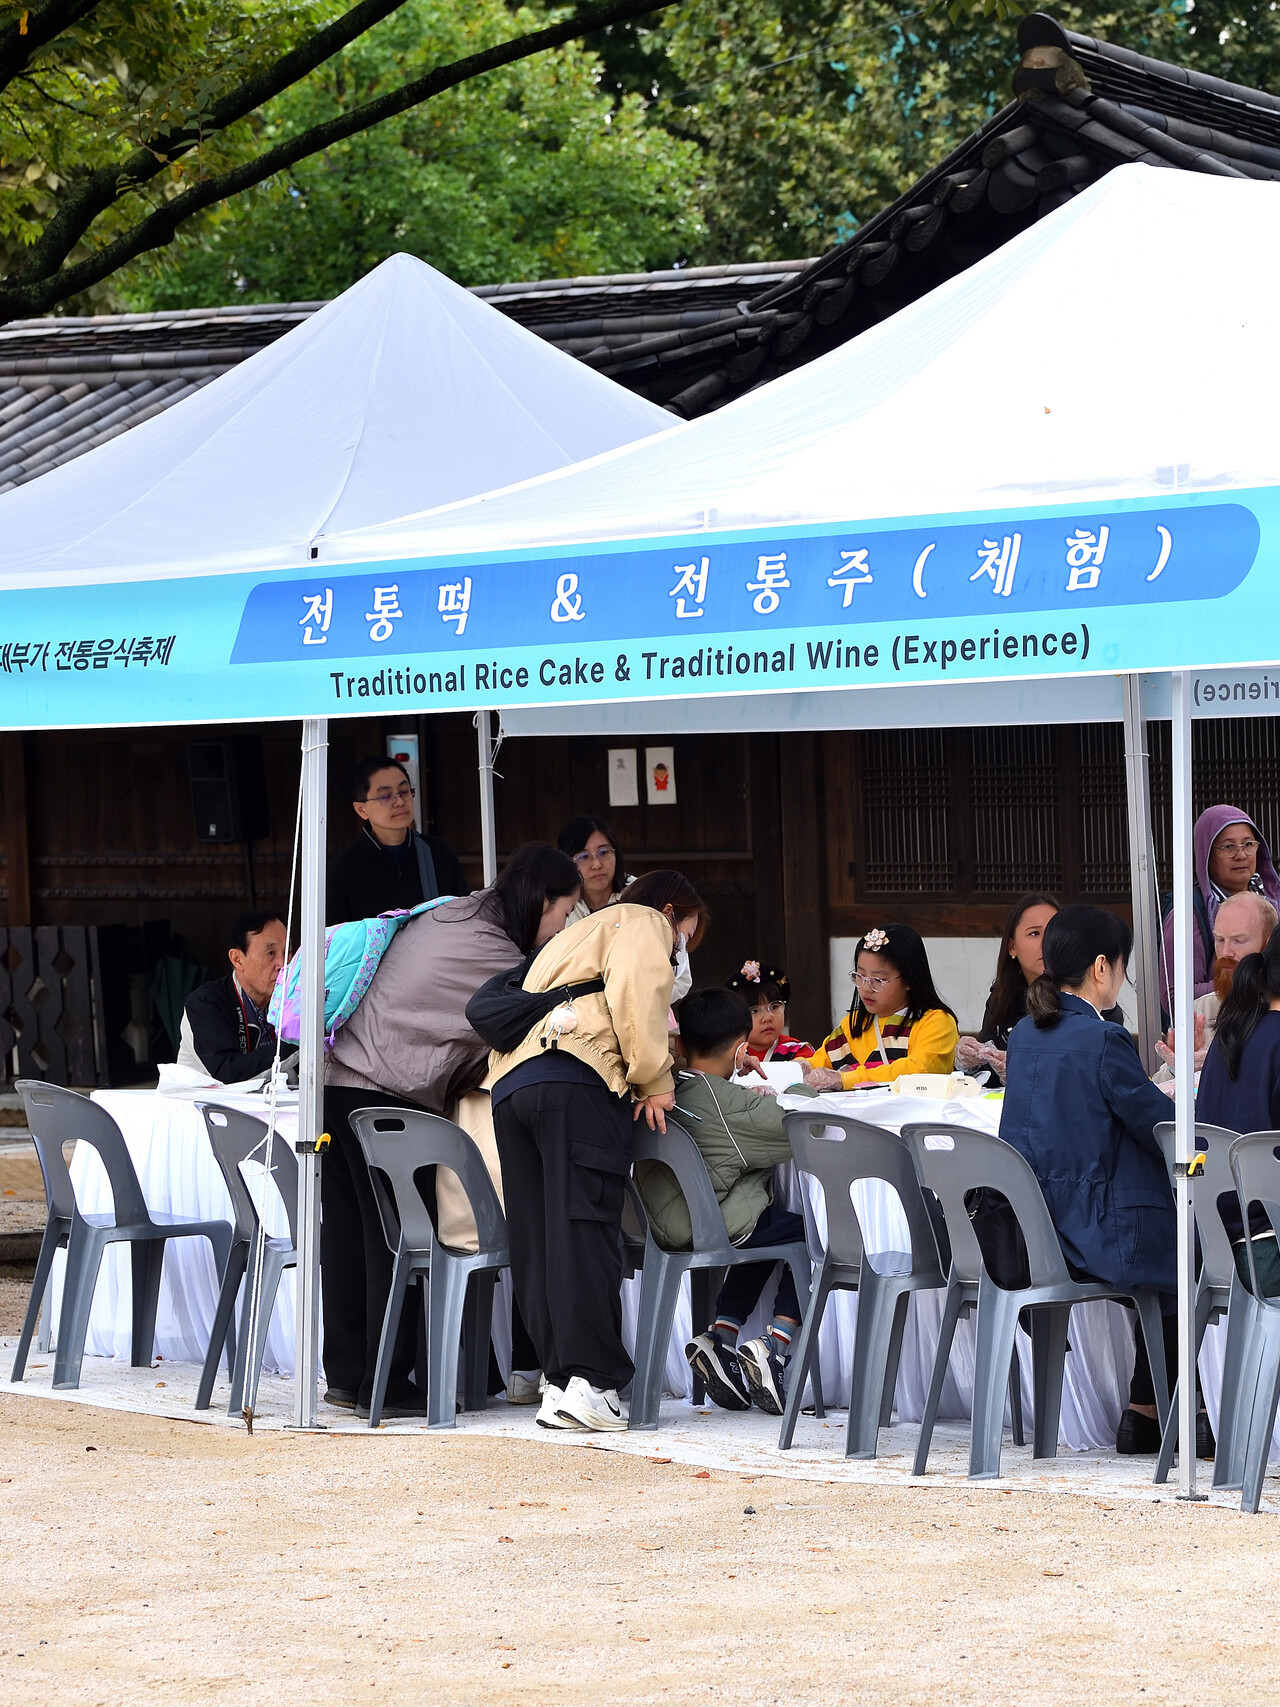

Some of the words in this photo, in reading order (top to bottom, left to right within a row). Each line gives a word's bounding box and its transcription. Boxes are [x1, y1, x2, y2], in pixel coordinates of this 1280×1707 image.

[548, 573, 586, 623] &
[54, 635, 177, 670] 전통음식축제
[330, 665, 466, 699] Traditional
[474, 658, 529, 691] Rice
[538, 655, 604, 688] Cake
[614, 656, 631, 682] &
[642, 642, 795, 681] Traditional
[806, 636, 879, 670] Wine
[891, 623, 1091, 672] (Experience)
